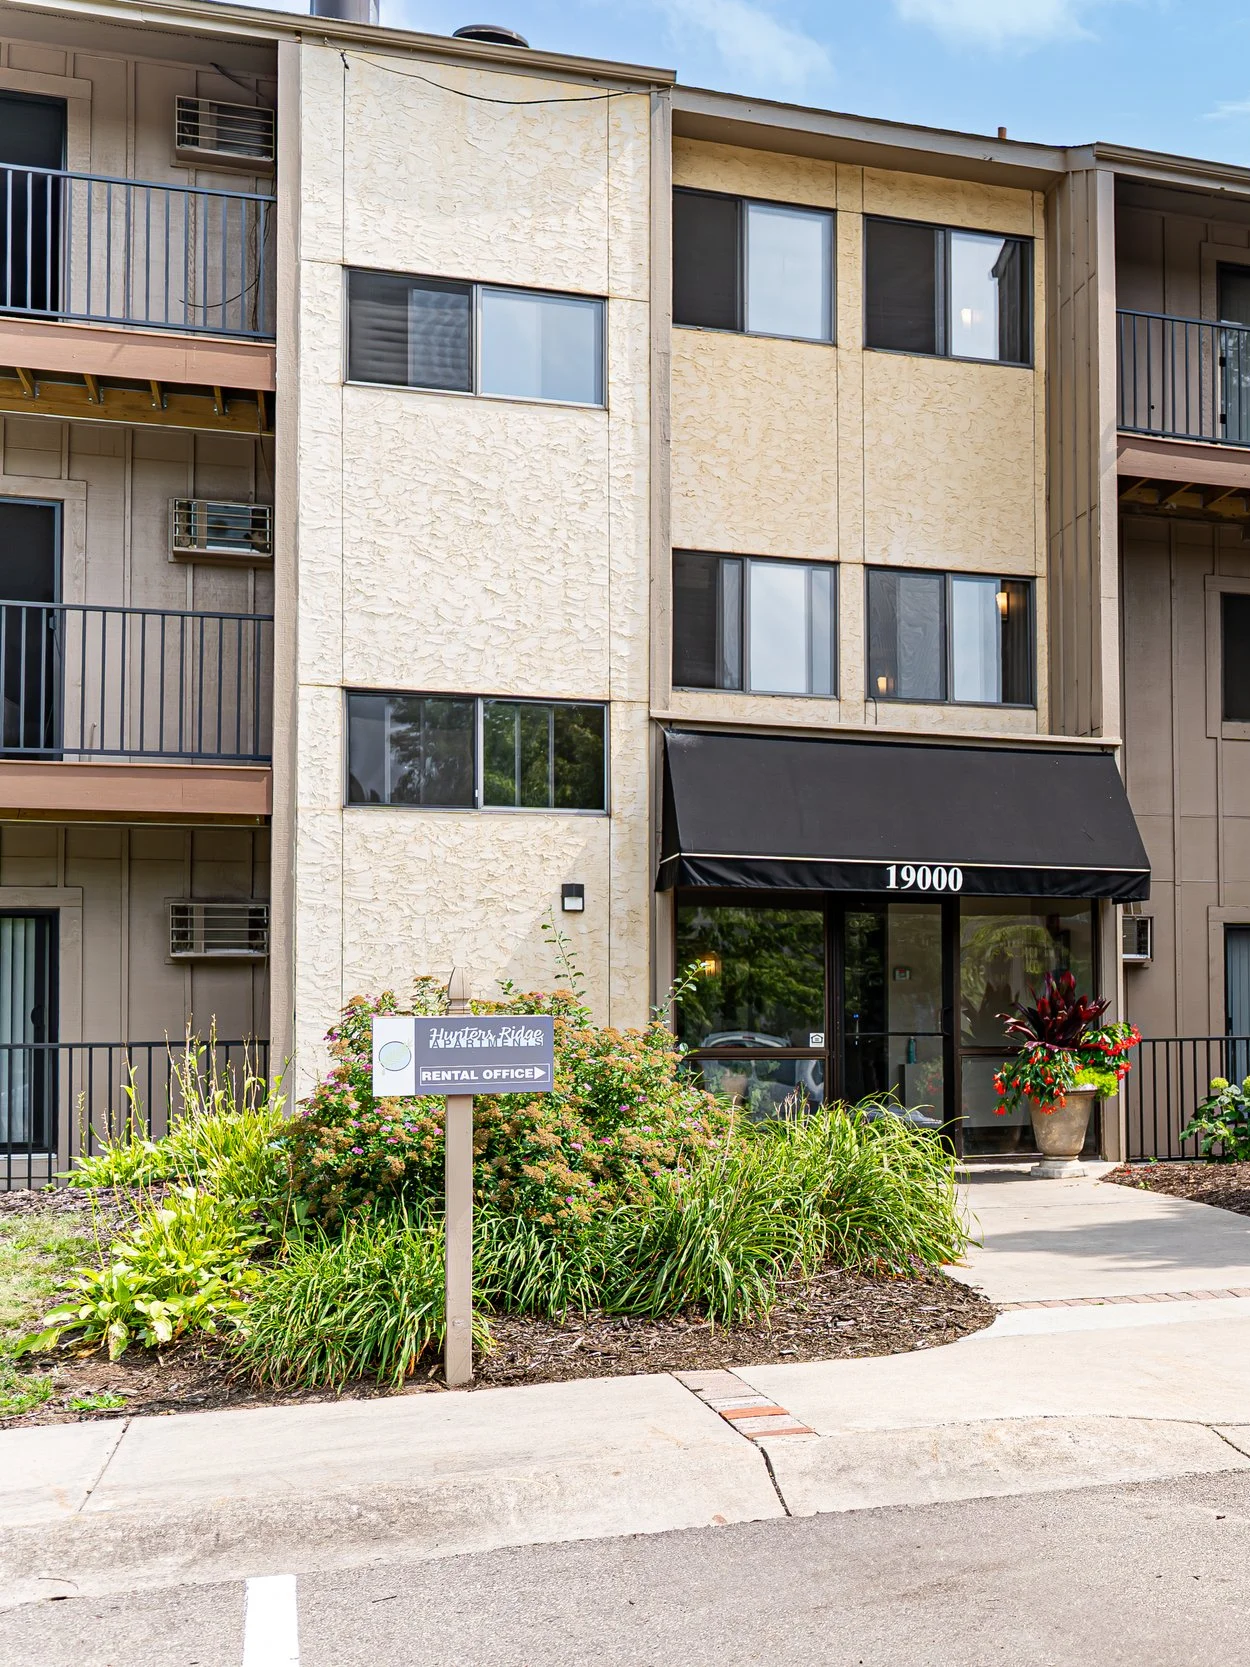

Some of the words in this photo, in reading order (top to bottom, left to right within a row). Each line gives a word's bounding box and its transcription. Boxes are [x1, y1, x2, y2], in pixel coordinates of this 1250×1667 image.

[886, 864, 963, 891] 19000
[429, 1027, 496, 1041] Hunters
[499, 1025, 544, 1041] Ridge
[421, 1069, 478, 1082] RENTAL
[482, 1068, 534, 1081] OFFICE
